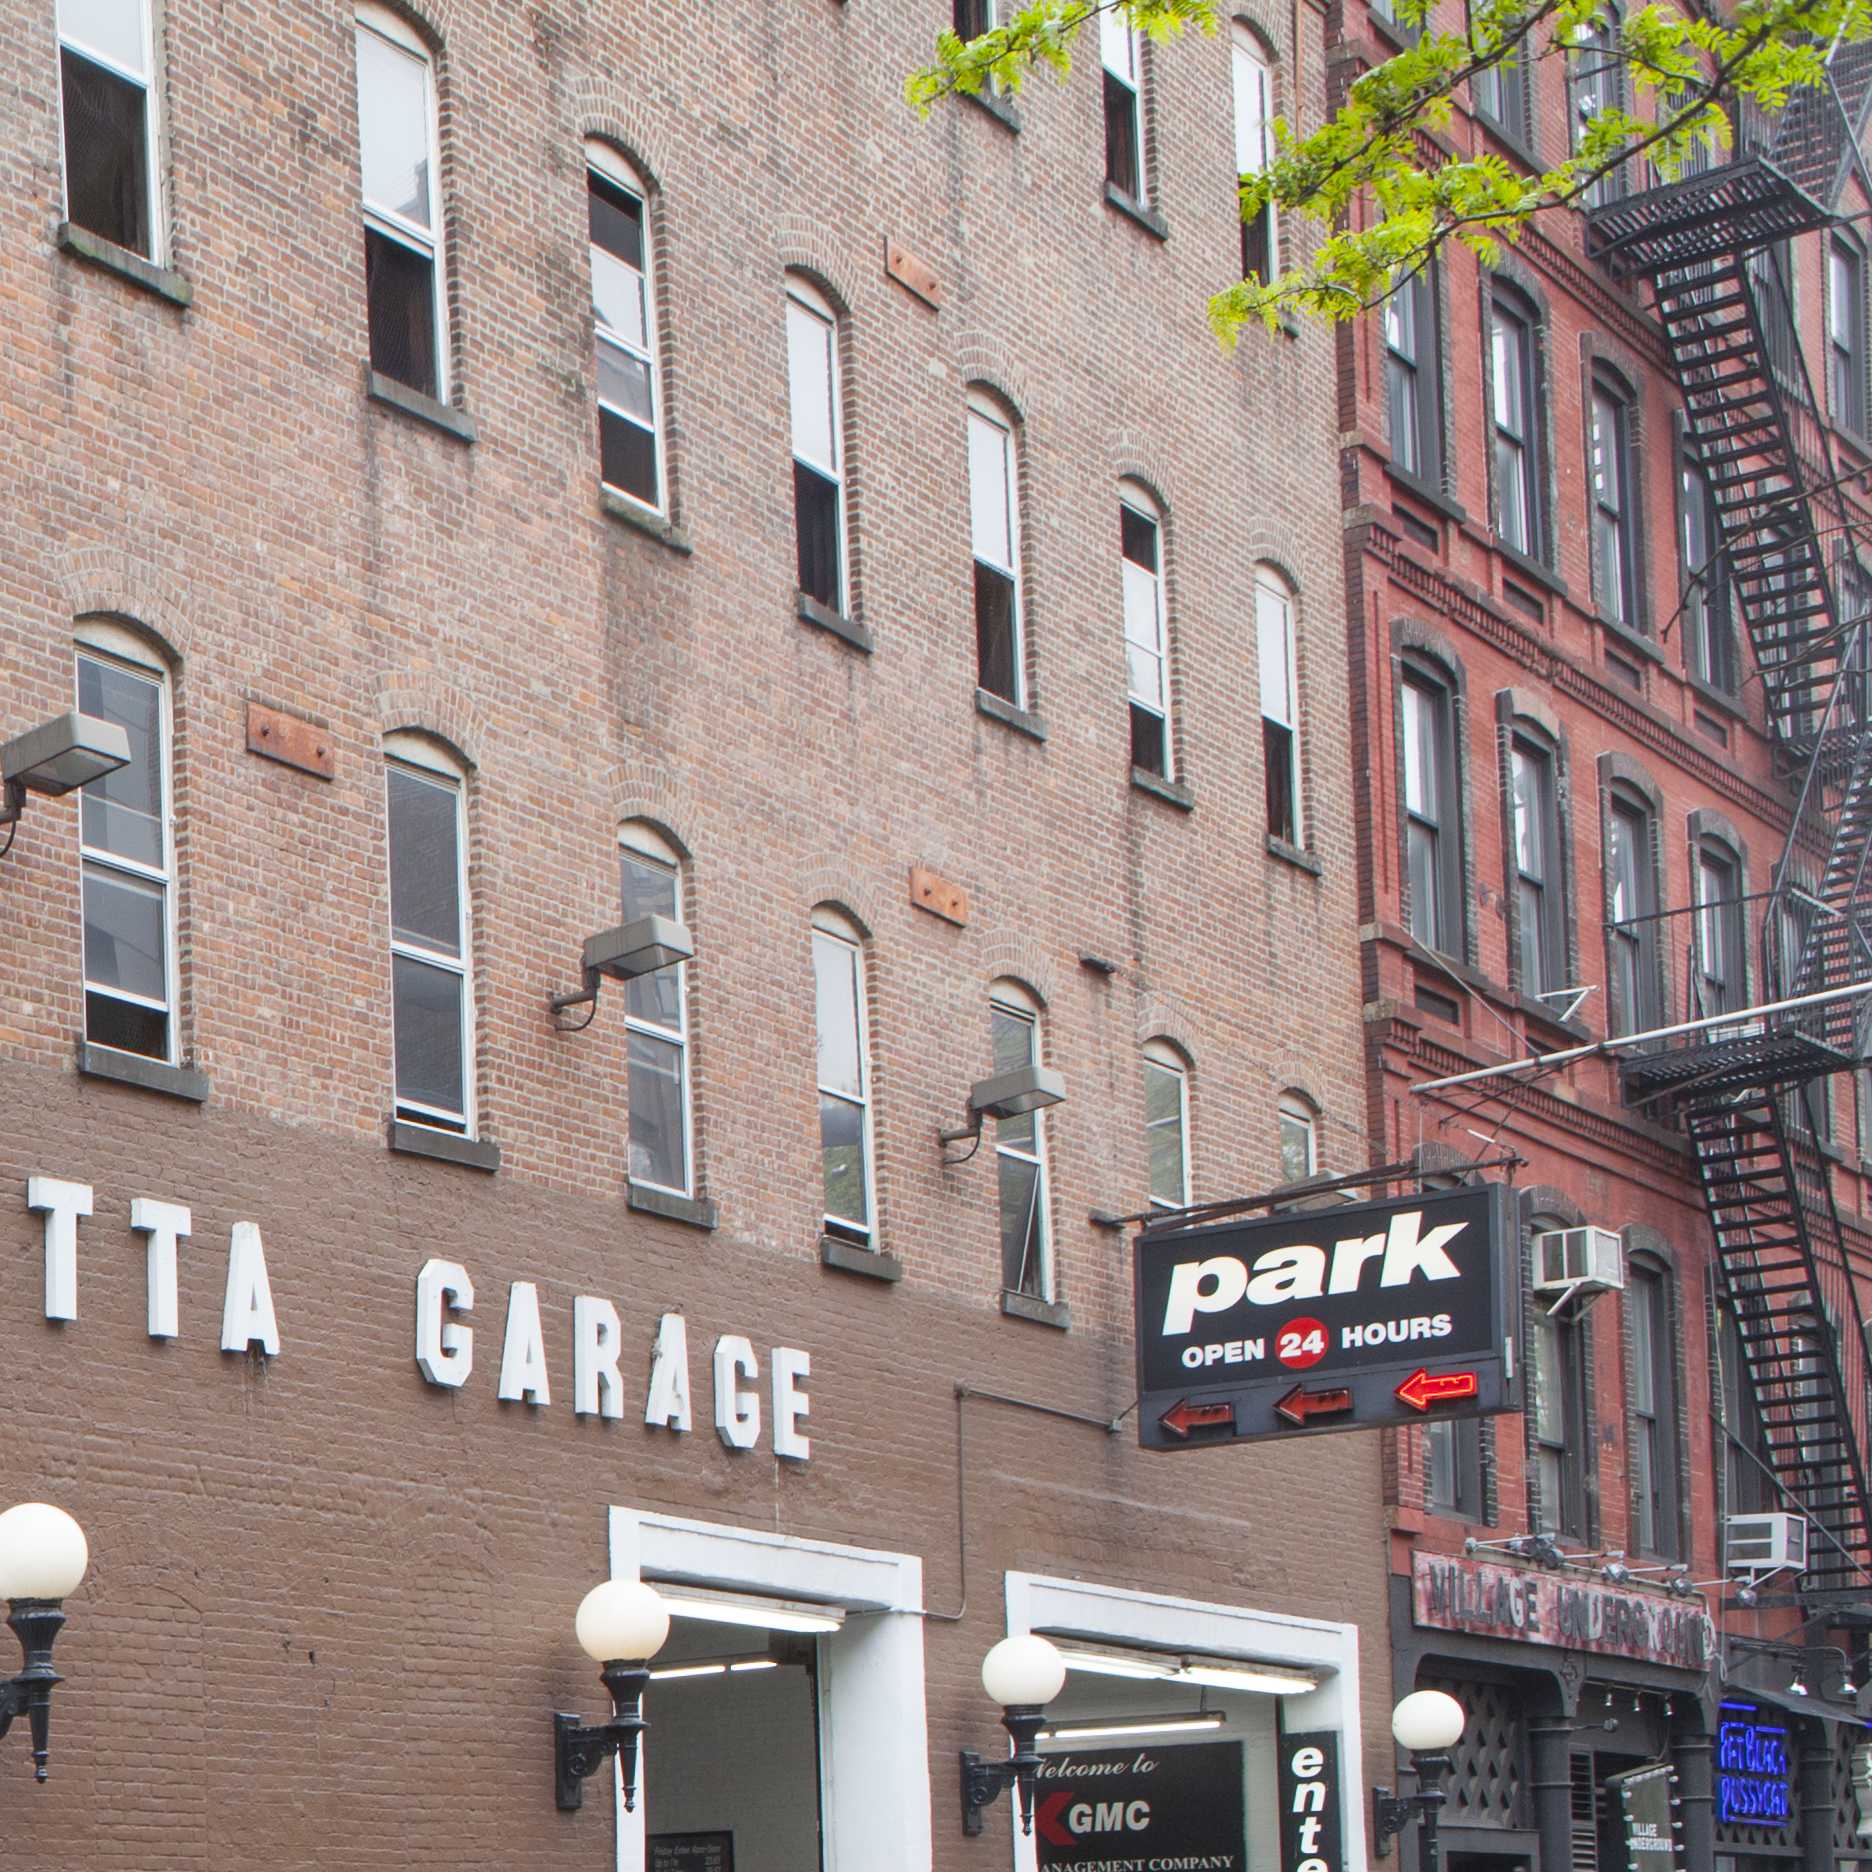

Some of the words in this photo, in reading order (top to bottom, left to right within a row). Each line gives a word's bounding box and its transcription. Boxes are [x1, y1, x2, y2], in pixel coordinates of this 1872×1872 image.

[1161, 1210, 1470, 1336] park
[415, 1258, 811, 1460] GARAGE
[1181, 1338, 1265, 1369] OPEN
[1279, 1330, 1325, 1358] 24
[1341, 1313, 1453, 1350] HOURS
[1428, 1561, 1541, 1634] VILLAGE
[1557, 1584, 1717, 1666] UNDERGROUND
[1132, 1752, 1158, 1774] to
[1068, 1799, 1151, 1834] GMC
[1721, 1775, 1789, 1822] PUSSYCAT
[1148, 1855, 1234, 1872] COMPANY
